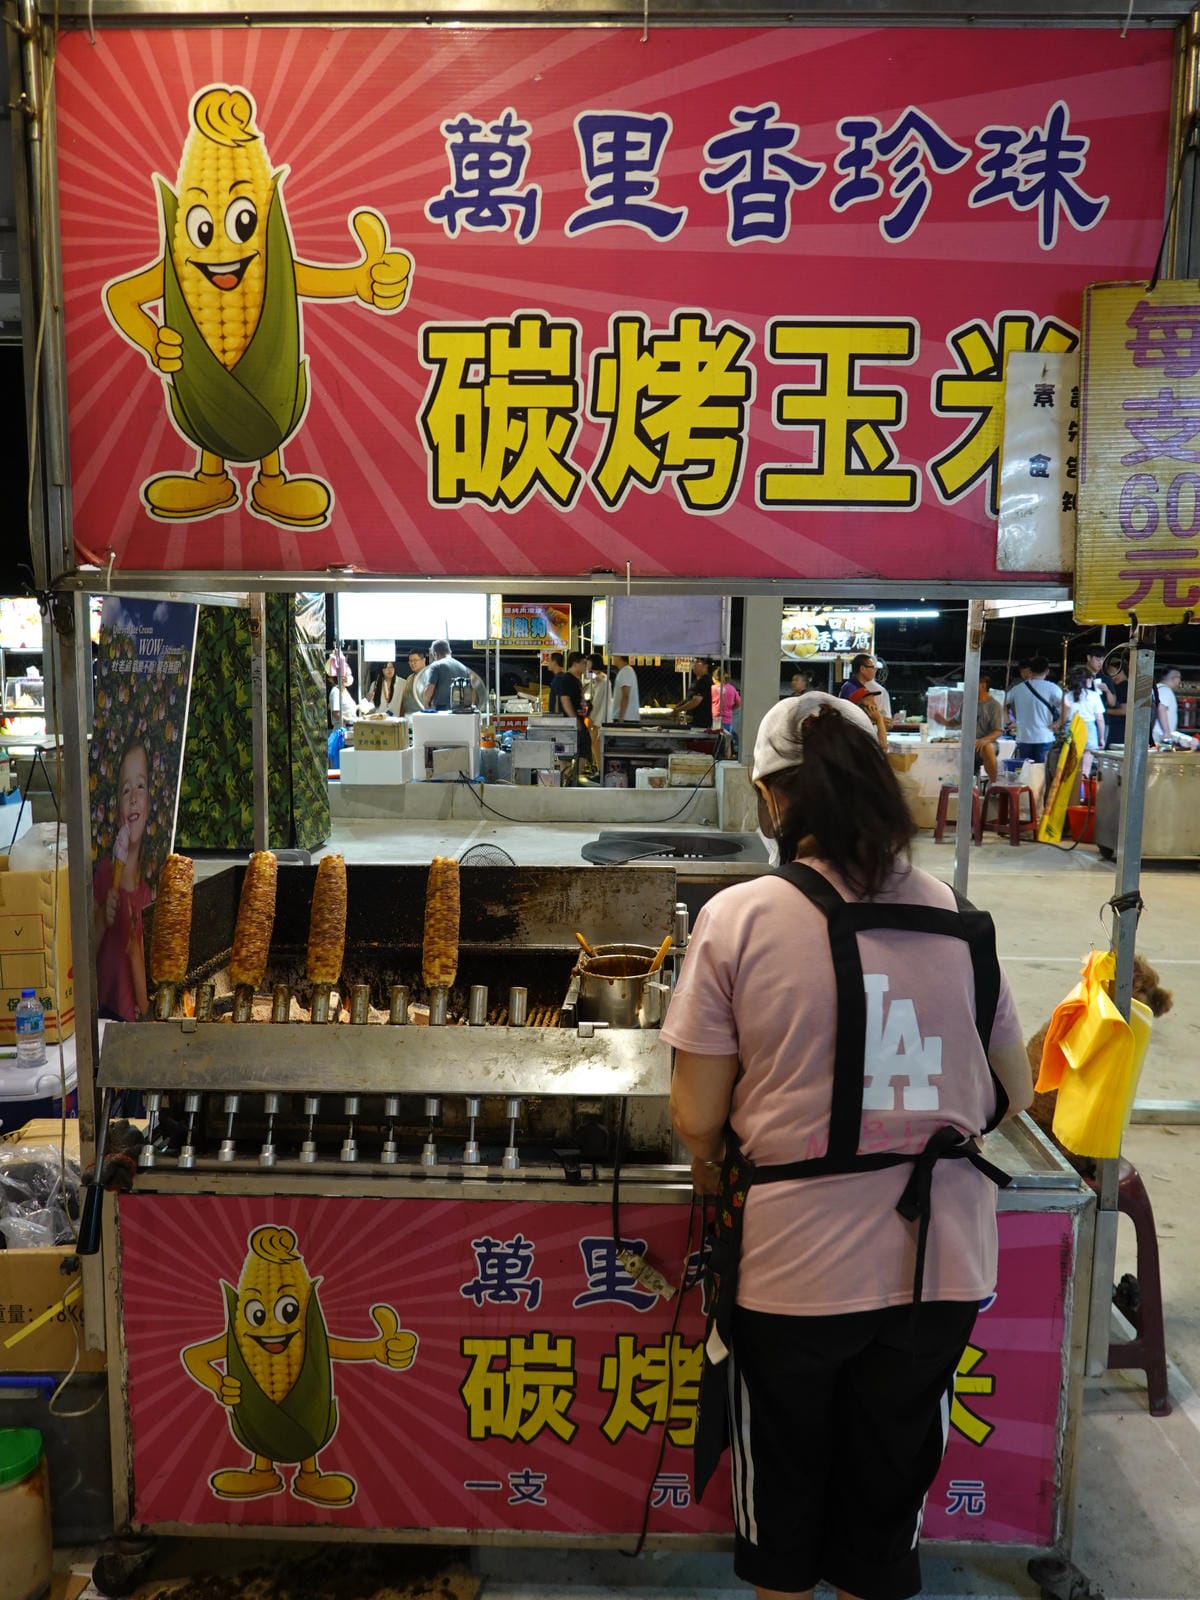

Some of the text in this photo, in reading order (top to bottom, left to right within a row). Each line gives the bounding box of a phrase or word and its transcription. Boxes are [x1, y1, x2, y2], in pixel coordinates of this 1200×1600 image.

[425, 101, 1109, 249] 萬里香珍珠
[139, 638, 164, 656] WOW
[862, 974, 942, 1110] LA
[464, 1468, 986, 1516] 一支 元 元
